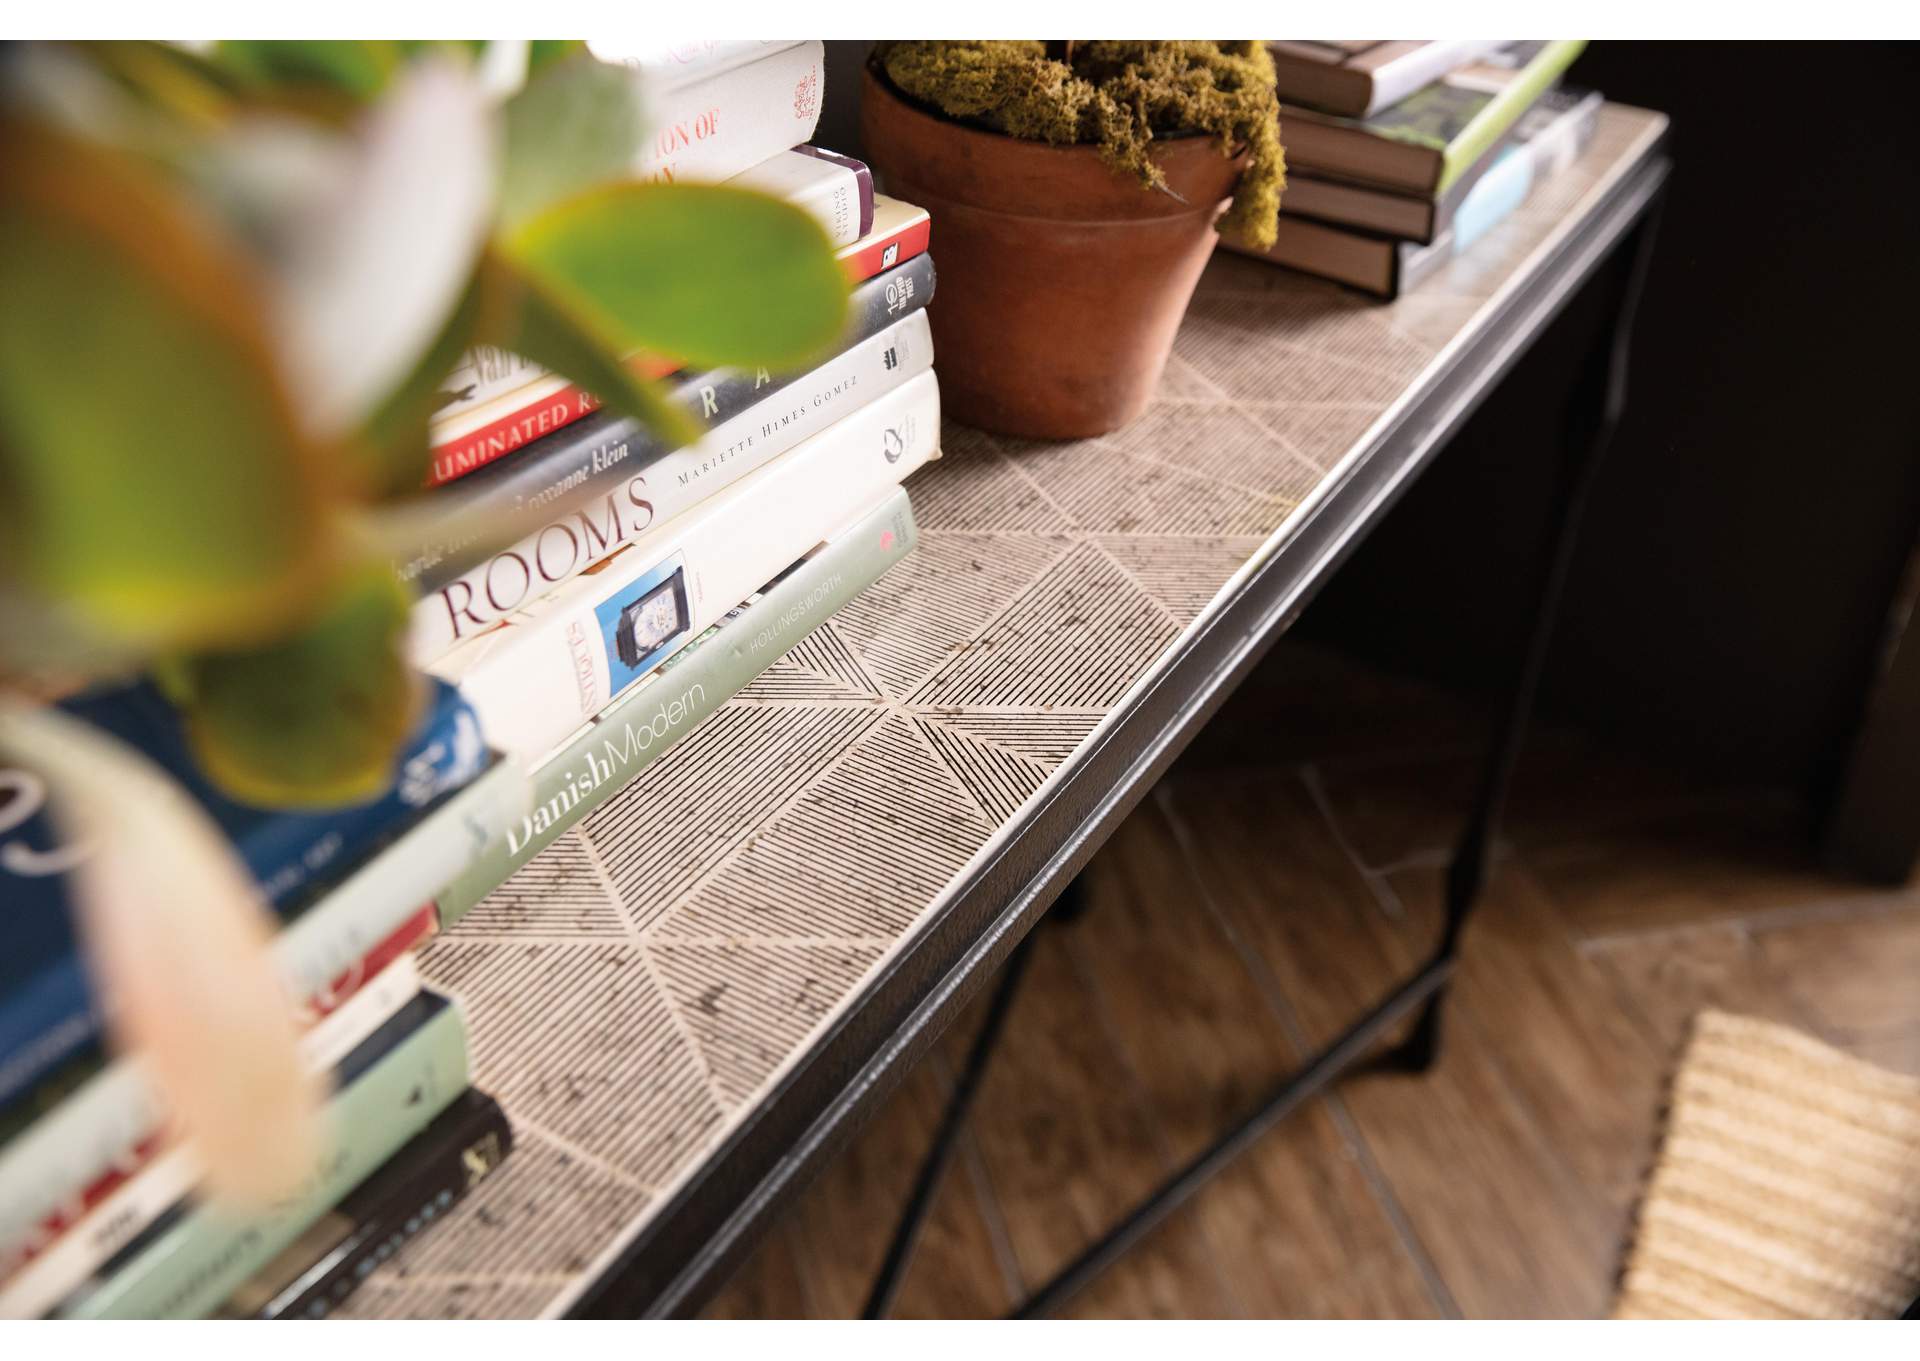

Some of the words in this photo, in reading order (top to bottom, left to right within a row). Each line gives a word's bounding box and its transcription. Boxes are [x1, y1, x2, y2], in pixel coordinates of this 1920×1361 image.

[433, 403, 568, 482] UMINATED
[591, 440, 629, 476] klein
[677, 435, 753, 488] MARIETTE
[761, 405, 807, 439] HIMES
[812, 374, 858, 408] GOMEZ
[441, 476, 655, 640] ROOMS
[749, 571, 842, 657] HOLLINGSWORTH
